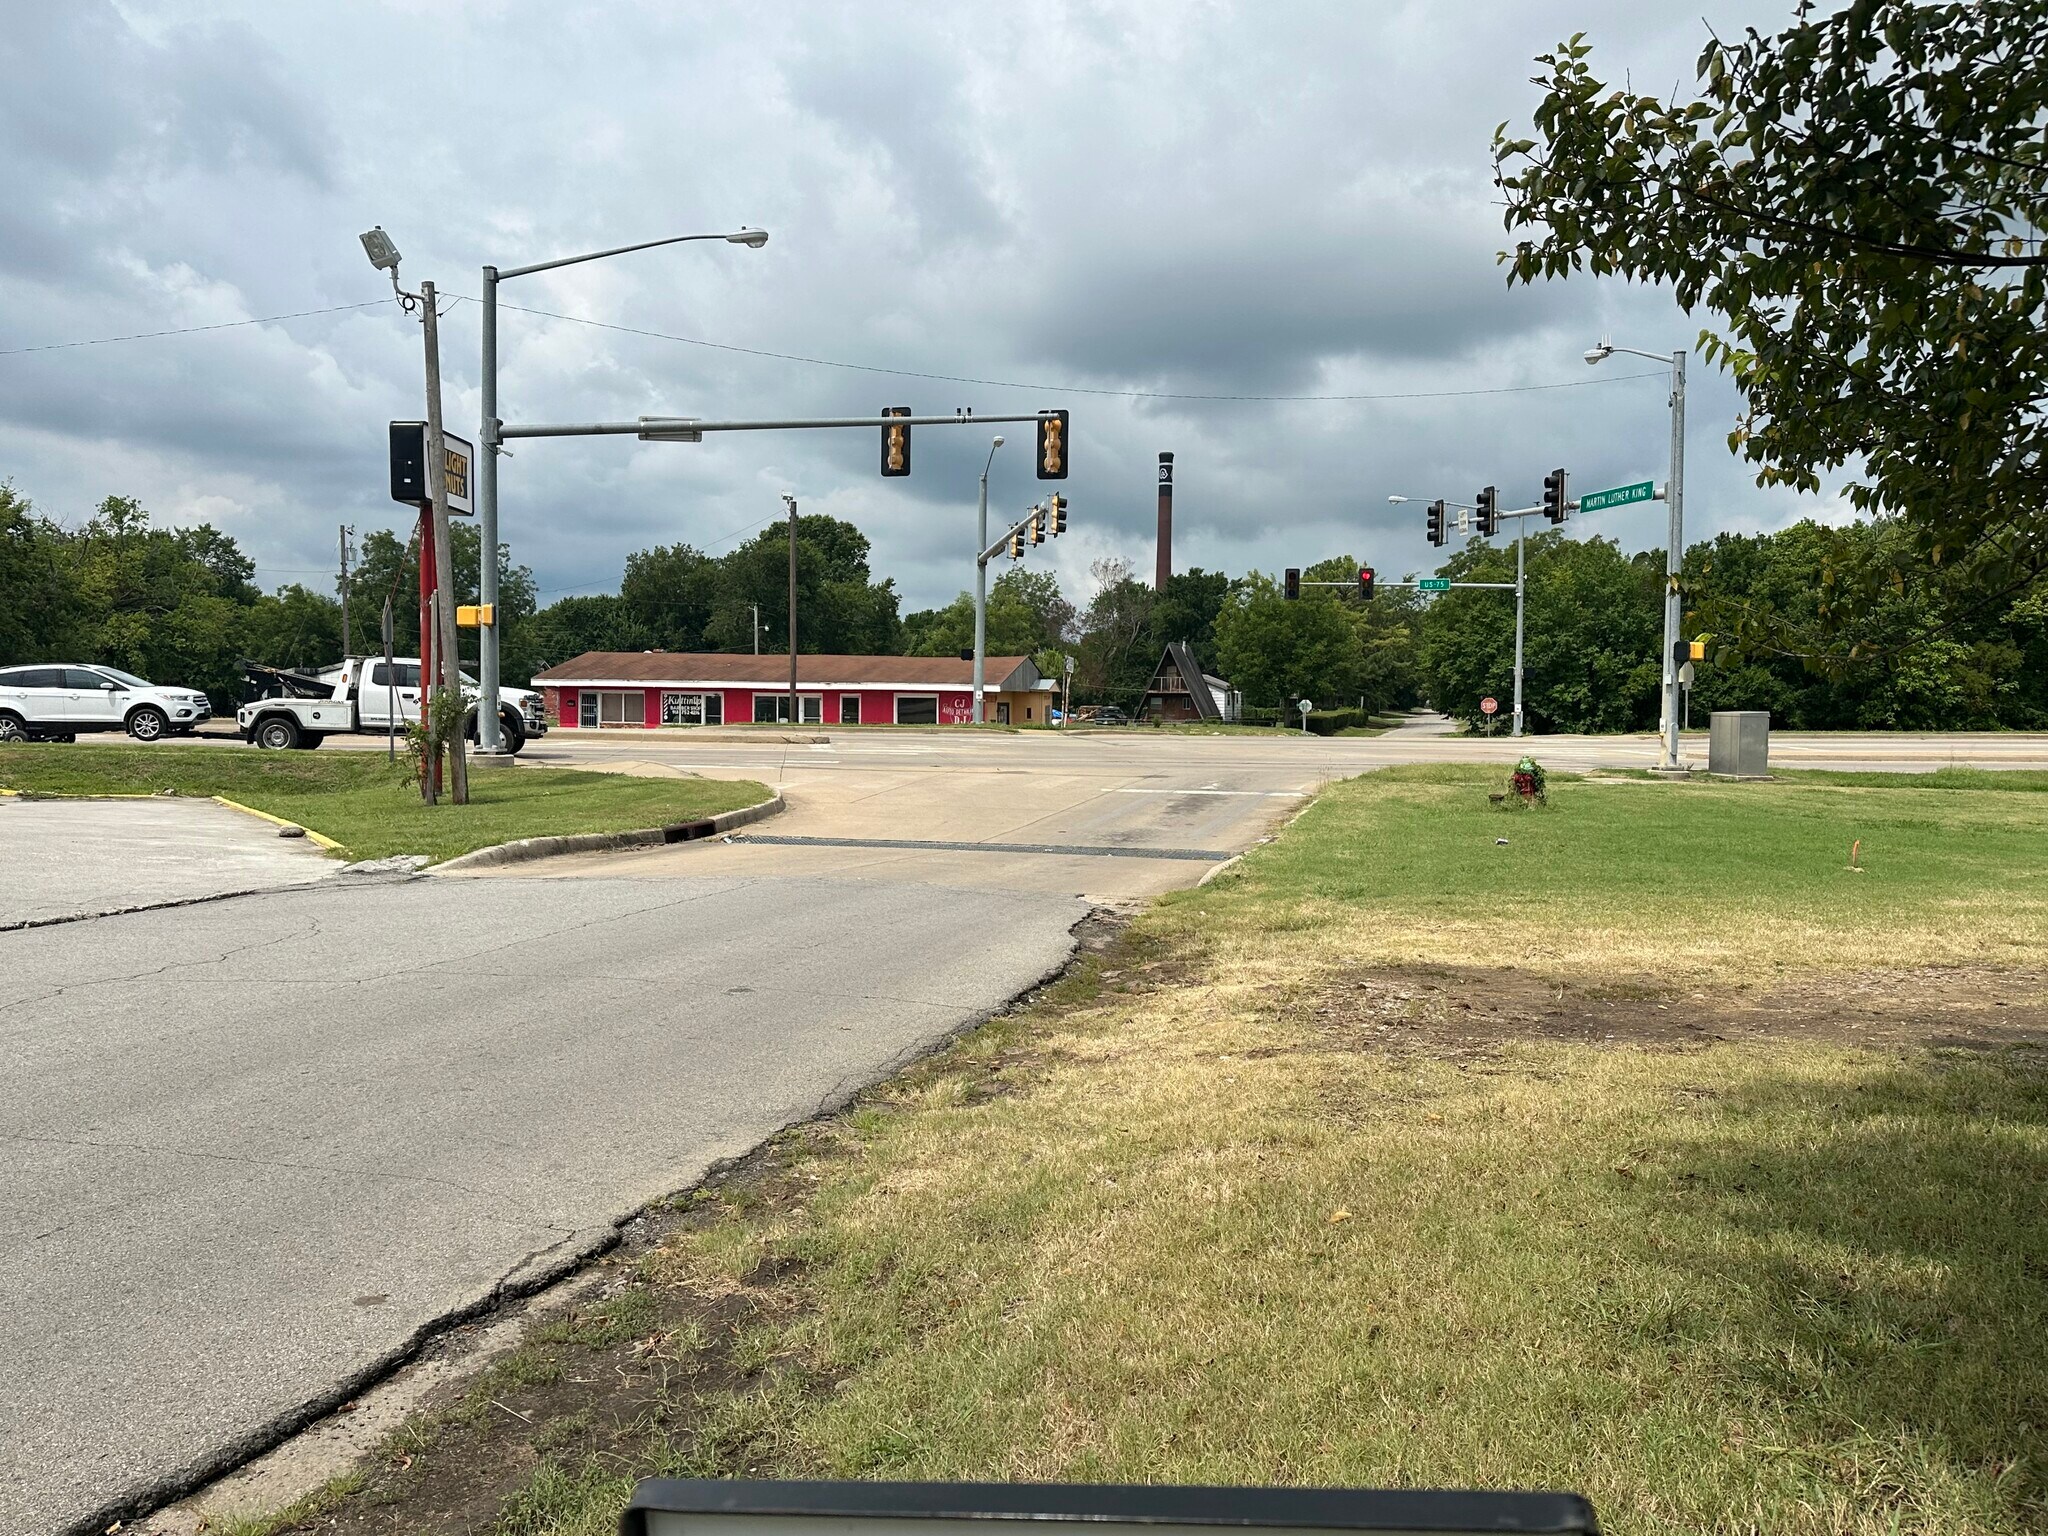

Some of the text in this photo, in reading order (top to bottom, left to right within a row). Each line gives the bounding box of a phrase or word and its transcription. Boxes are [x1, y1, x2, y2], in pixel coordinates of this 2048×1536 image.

[444, 450, 467, 476] LIGHT
[445, 471, 465, 496] NUTS
[1585, 486, 1647, 509] MARTIN LUTHER KING
[1424, 580, 1444, 588] US-75
[954, 698, 965, 708] CJ
